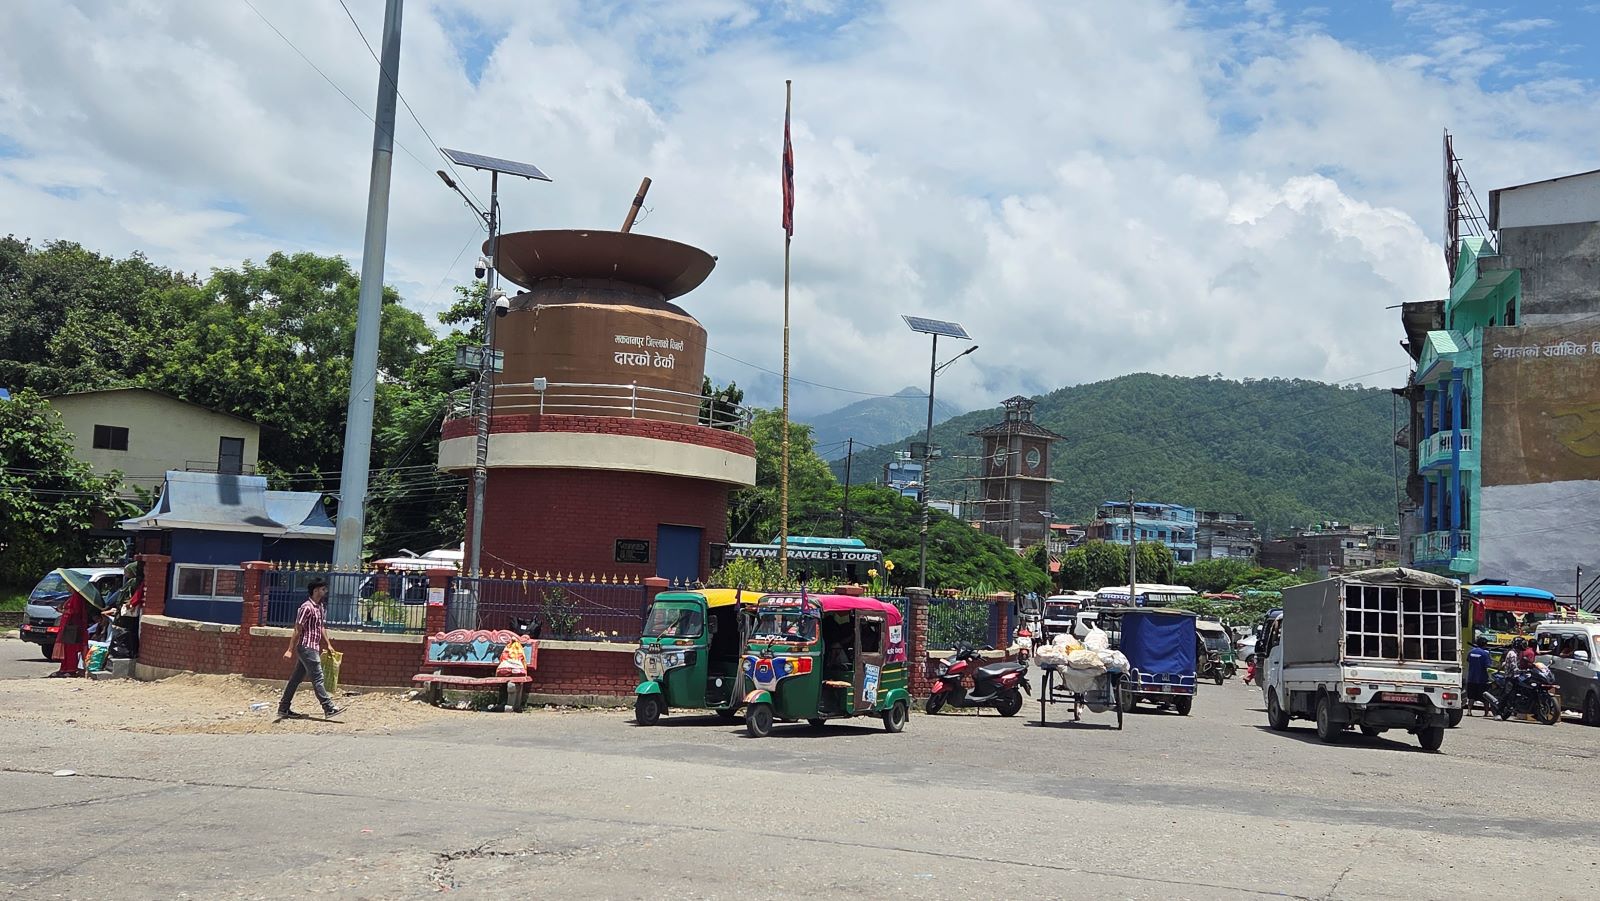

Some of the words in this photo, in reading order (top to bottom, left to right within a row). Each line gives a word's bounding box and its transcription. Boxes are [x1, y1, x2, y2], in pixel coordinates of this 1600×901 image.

[1493, 344, 1540, 358] नेपालको
[614, 350, 651, 367] दारको
[653, 351, 675, 370] ठेकी
[725, 548, 778, 558] SATYAM
[786, 550, 830, 560] RAVELS
[842, 552, 878, 561] TOURS
